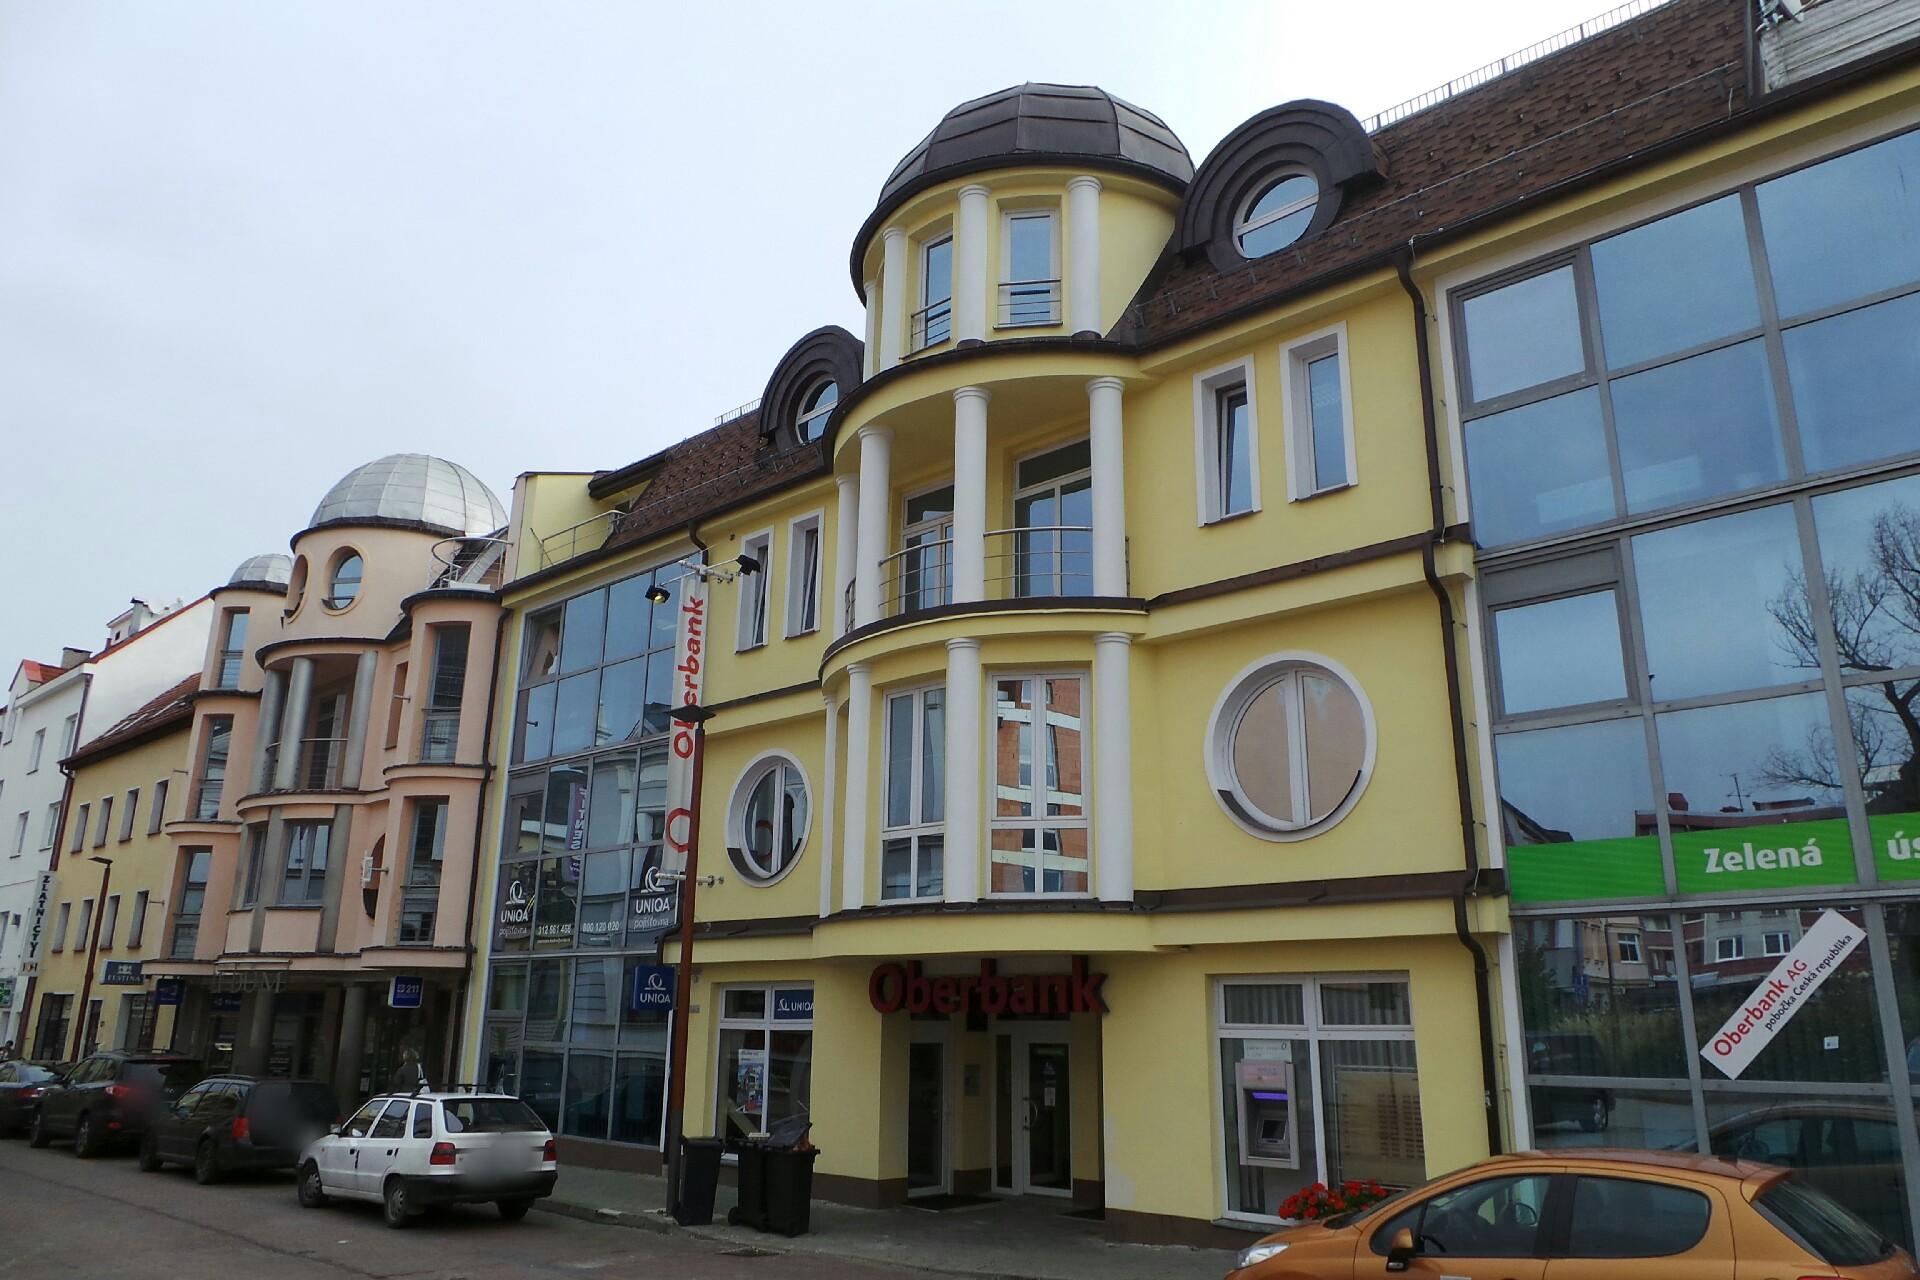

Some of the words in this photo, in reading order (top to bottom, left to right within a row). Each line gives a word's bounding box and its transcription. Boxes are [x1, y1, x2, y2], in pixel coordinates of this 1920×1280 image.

[1704, 838, 1823, 873] Zelená
[501, 908, 529, 923] UNIQA
[636, 897, 670, 914] UNIQA
[639, 993, 671, 1004] UNIQA
[869, 955, 1109, 1015] Oberbank
[1764, 994, 1797, 1032] pobočka
[1816, 933, 1853, 974] republika
[1714, 977, 1790, 1057] Oberbank
[1786, 958, 1808, 982] AG
